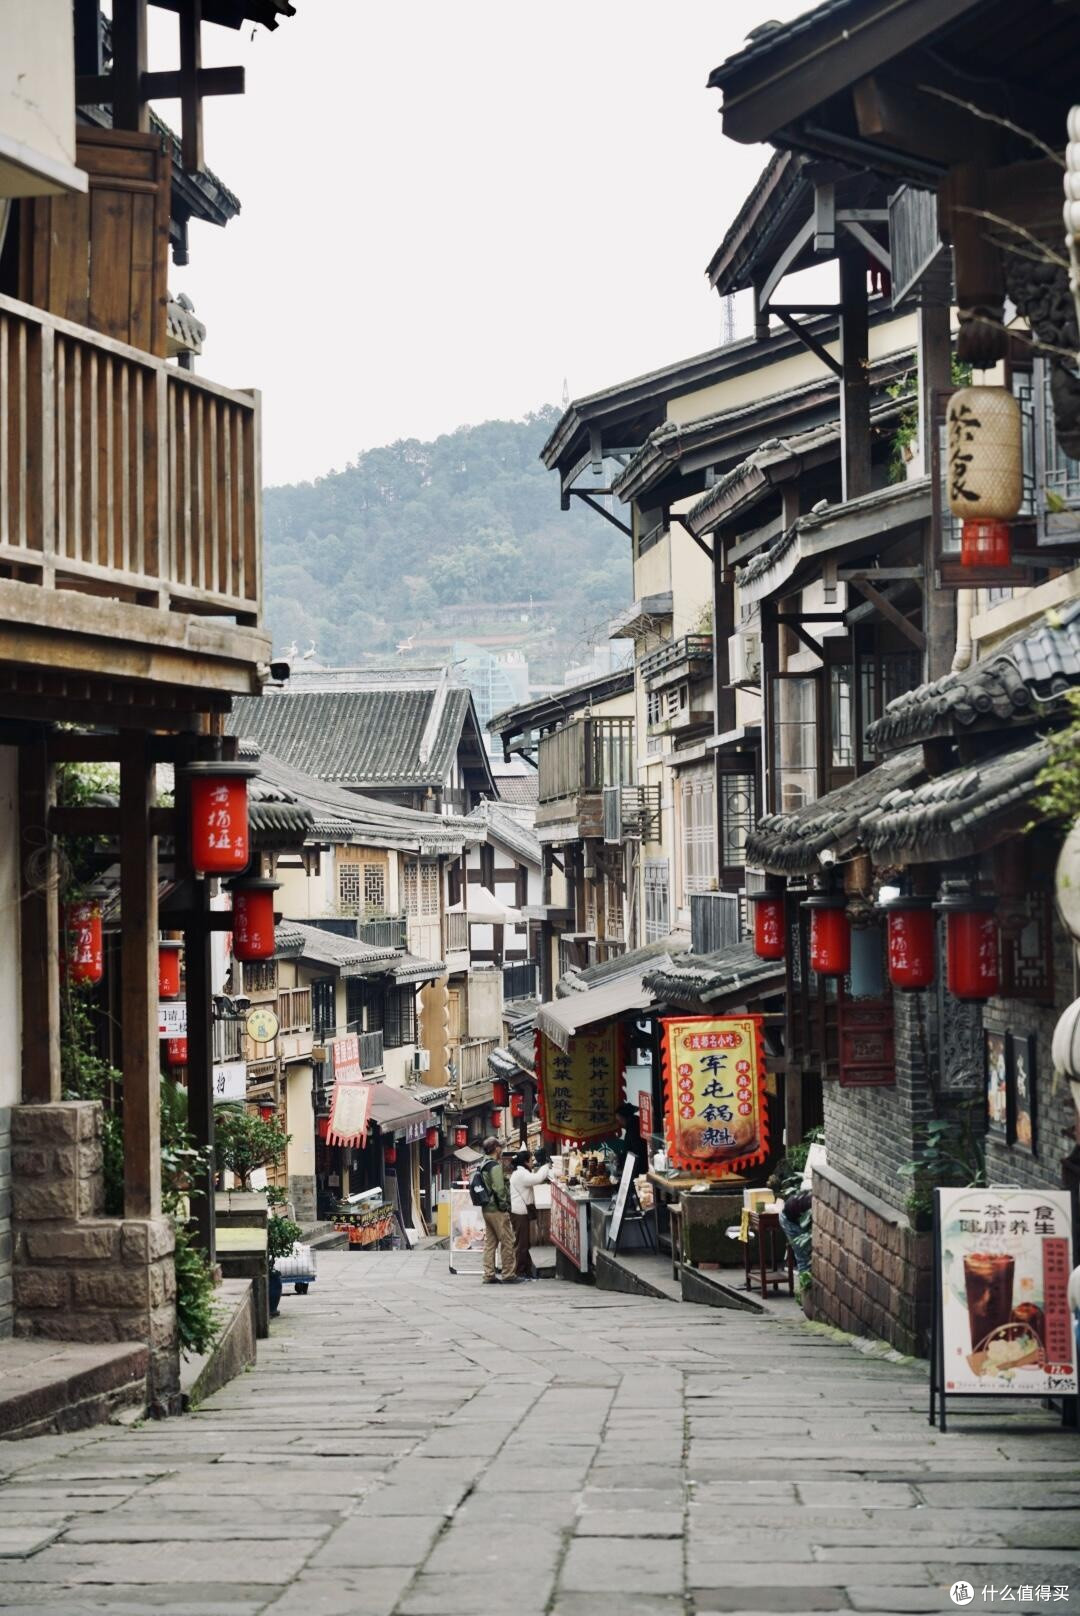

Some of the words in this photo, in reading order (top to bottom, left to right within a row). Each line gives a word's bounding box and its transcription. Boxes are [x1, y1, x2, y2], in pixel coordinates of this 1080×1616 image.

[691, 1034, 736, 1049] 成都名小吃
[552, 1056, 573, 1081] 榨菜
[589, 1056, 609, 1081] 桃片
[698, 1054, 737, 1147] 军屯锅魁
[960, 1204, 1055, 1221] 一茶一食
[960, 1219, 1056, 1235] 健康养生
